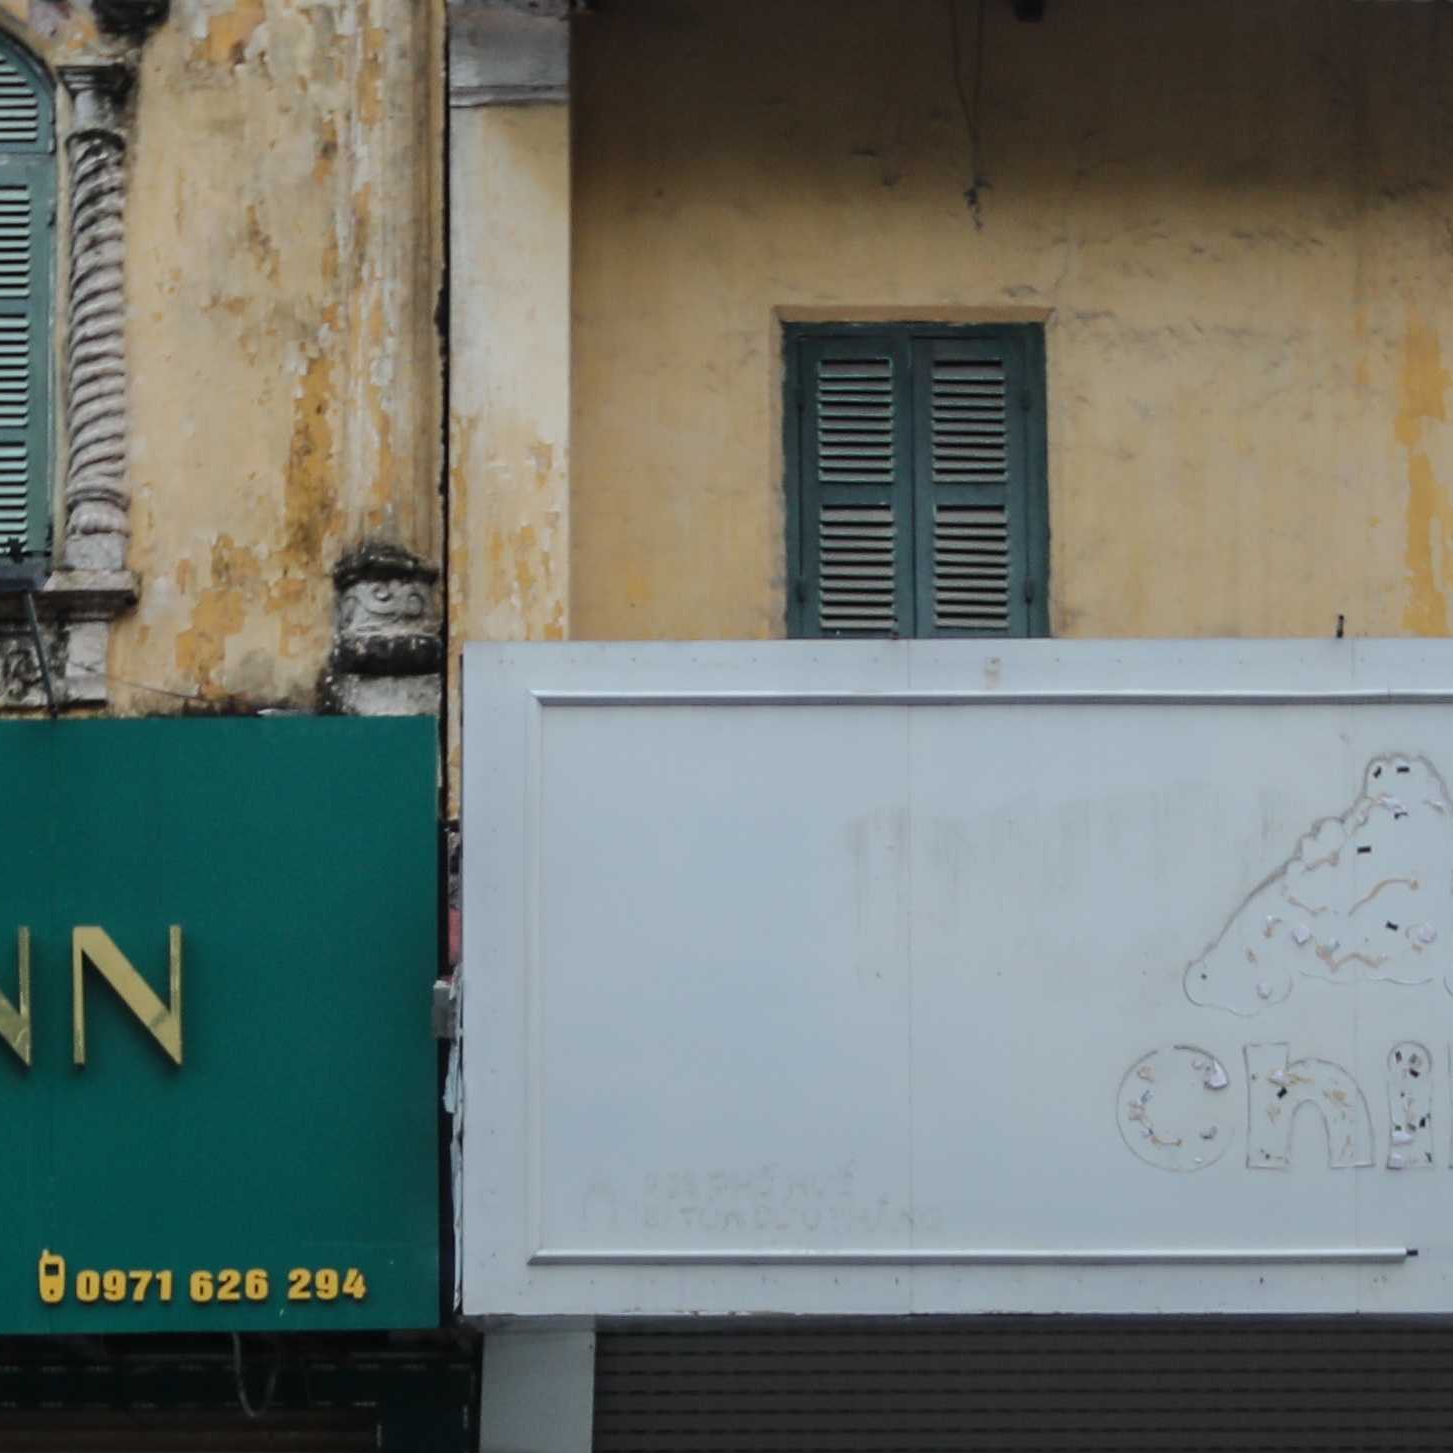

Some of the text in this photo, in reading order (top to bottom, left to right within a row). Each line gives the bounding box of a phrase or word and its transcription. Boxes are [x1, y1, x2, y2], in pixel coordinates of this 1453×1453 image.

[76, 1268, 367, 1303] 0971 626 294
